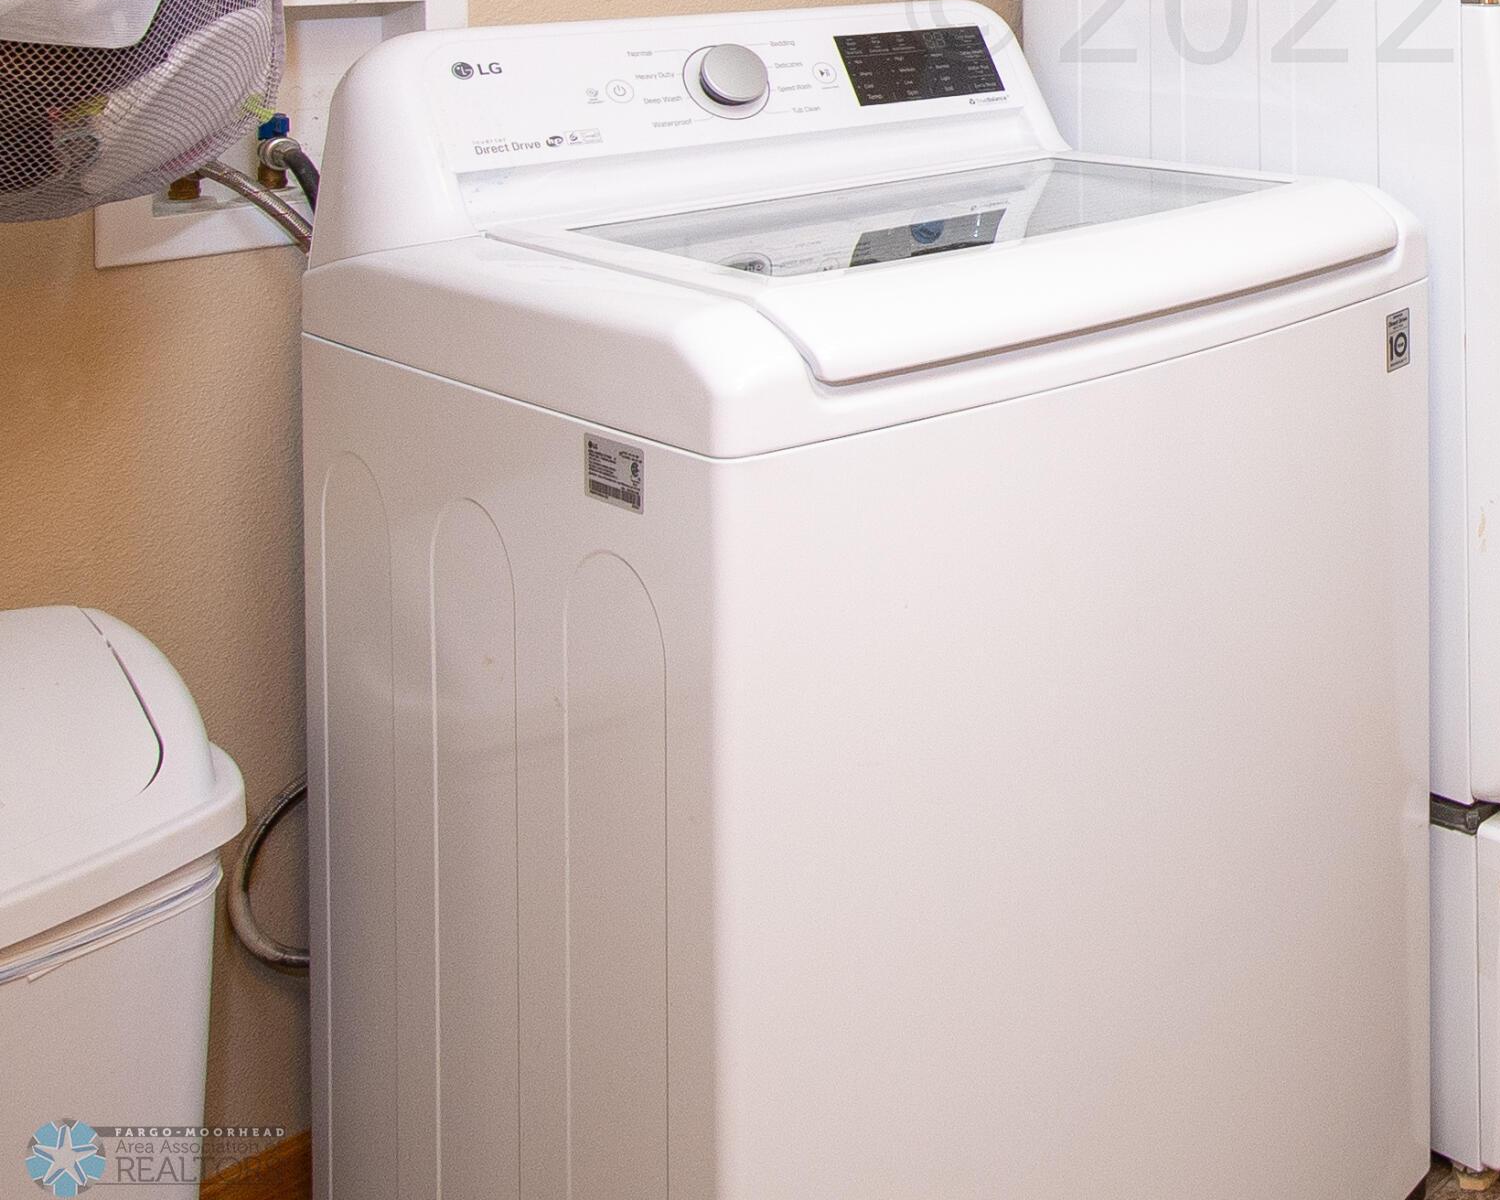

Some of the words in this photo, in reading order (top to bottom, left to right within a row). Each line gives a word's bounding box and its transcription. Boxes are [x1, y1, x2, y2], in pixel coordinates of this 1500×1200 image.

[477, 62, 503, 76] LG
[474, 143, 510, 156] Direct
[512, 140, 542, 152] Drive
